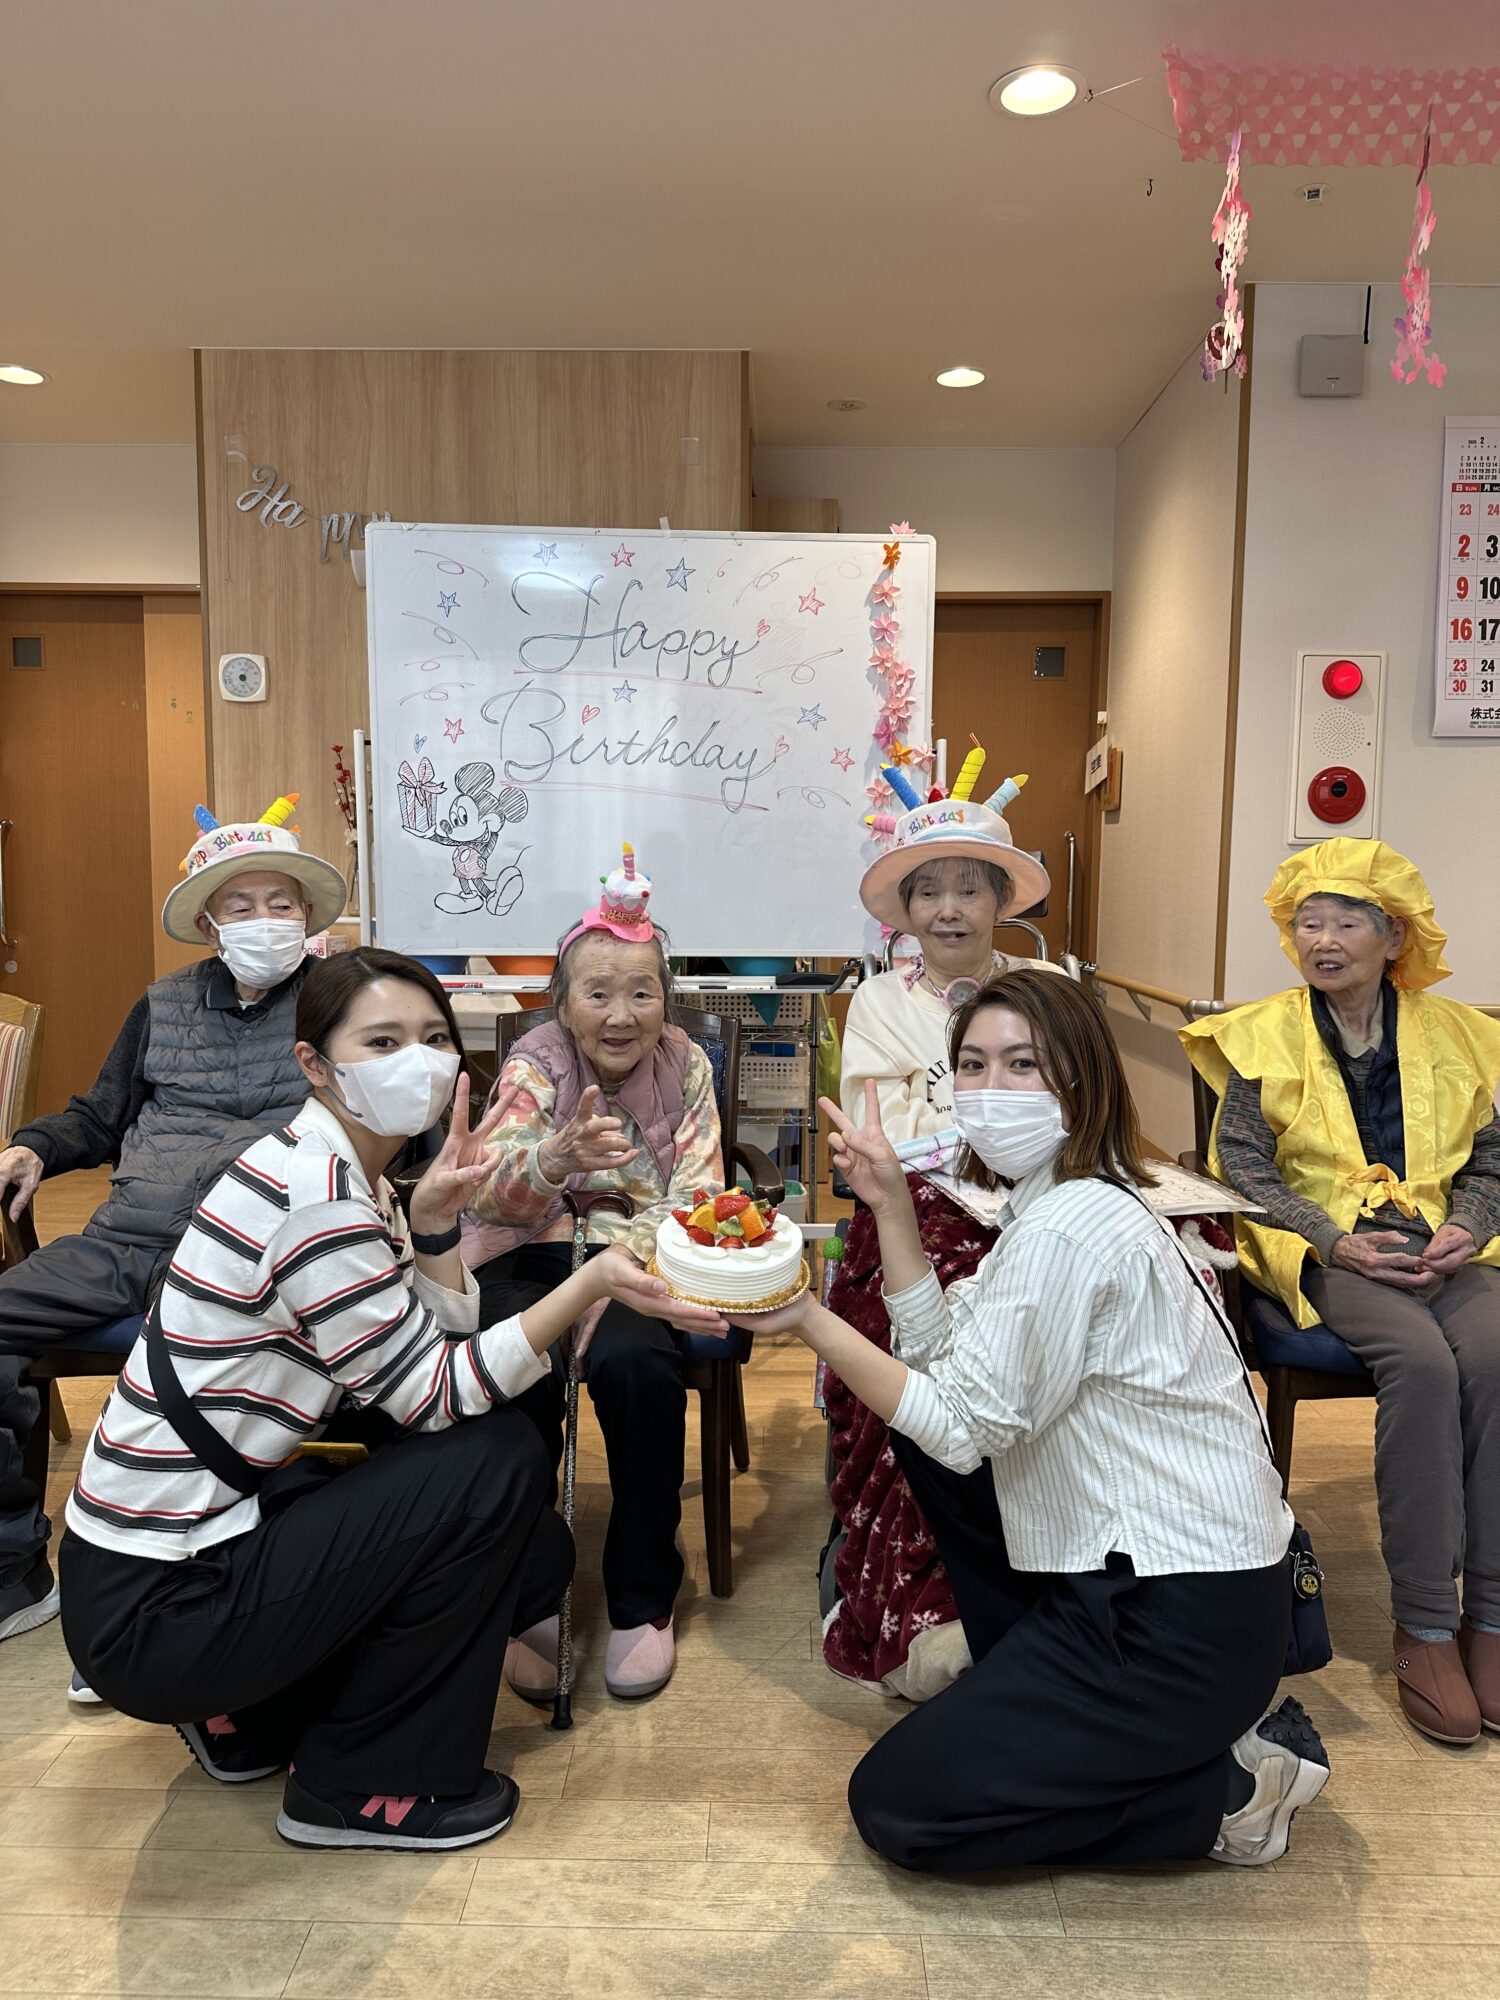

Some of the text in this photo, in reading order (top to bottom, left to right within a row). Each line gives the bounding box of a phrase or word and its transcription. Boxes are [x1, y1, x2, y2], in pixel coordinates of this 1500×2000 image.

[1480, 436, 1485, 444] 2
[236, 465, 392, 563] Happ
[1459, 504, 1500, 516] 23 24
[1457, 534, 1499, 558] 2 3
[1456, 576, 1500, 600] 9 10
[512, 571, 759, 688] Happy
[1450, 618, 1500, 641] 16 17
[1453, 659, 1495, 672] 23 24
[1453, 679, 1494, 693] 30 31
[481, 679, 778, 814] Birthday
